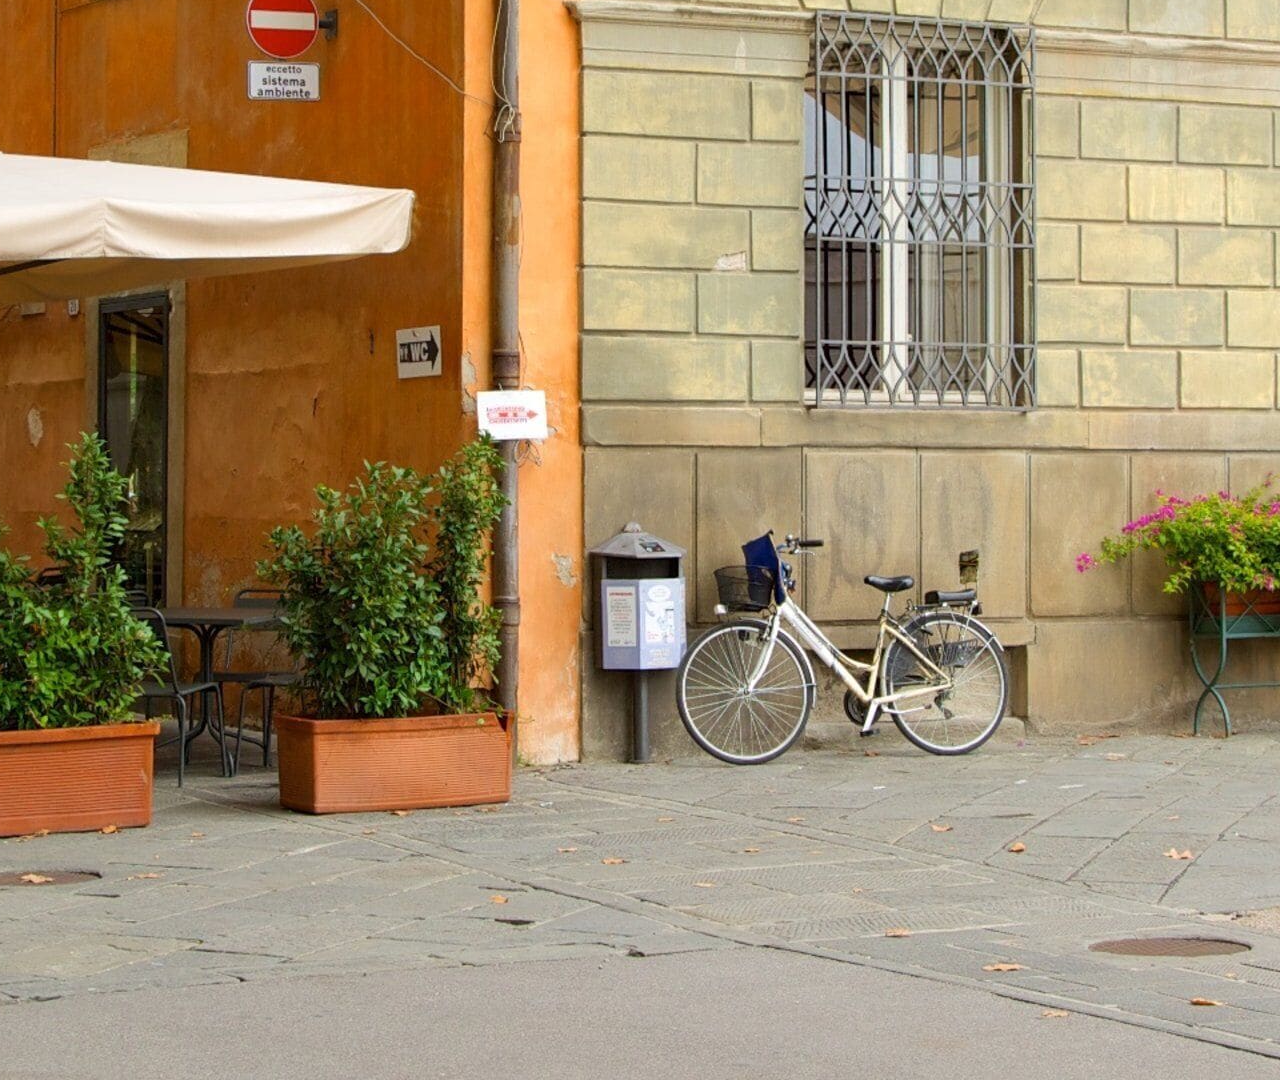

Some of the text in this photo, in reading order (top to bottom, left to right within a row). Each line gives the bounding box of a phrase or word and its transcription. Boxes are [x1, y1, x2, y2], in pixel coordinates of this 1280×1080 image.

[266, 65, 302, 74] eccetto
[262, 76, 306, 87] sistema
[257, 87, 311, 98] ambiente
[410, 342, 429, 361] WC
